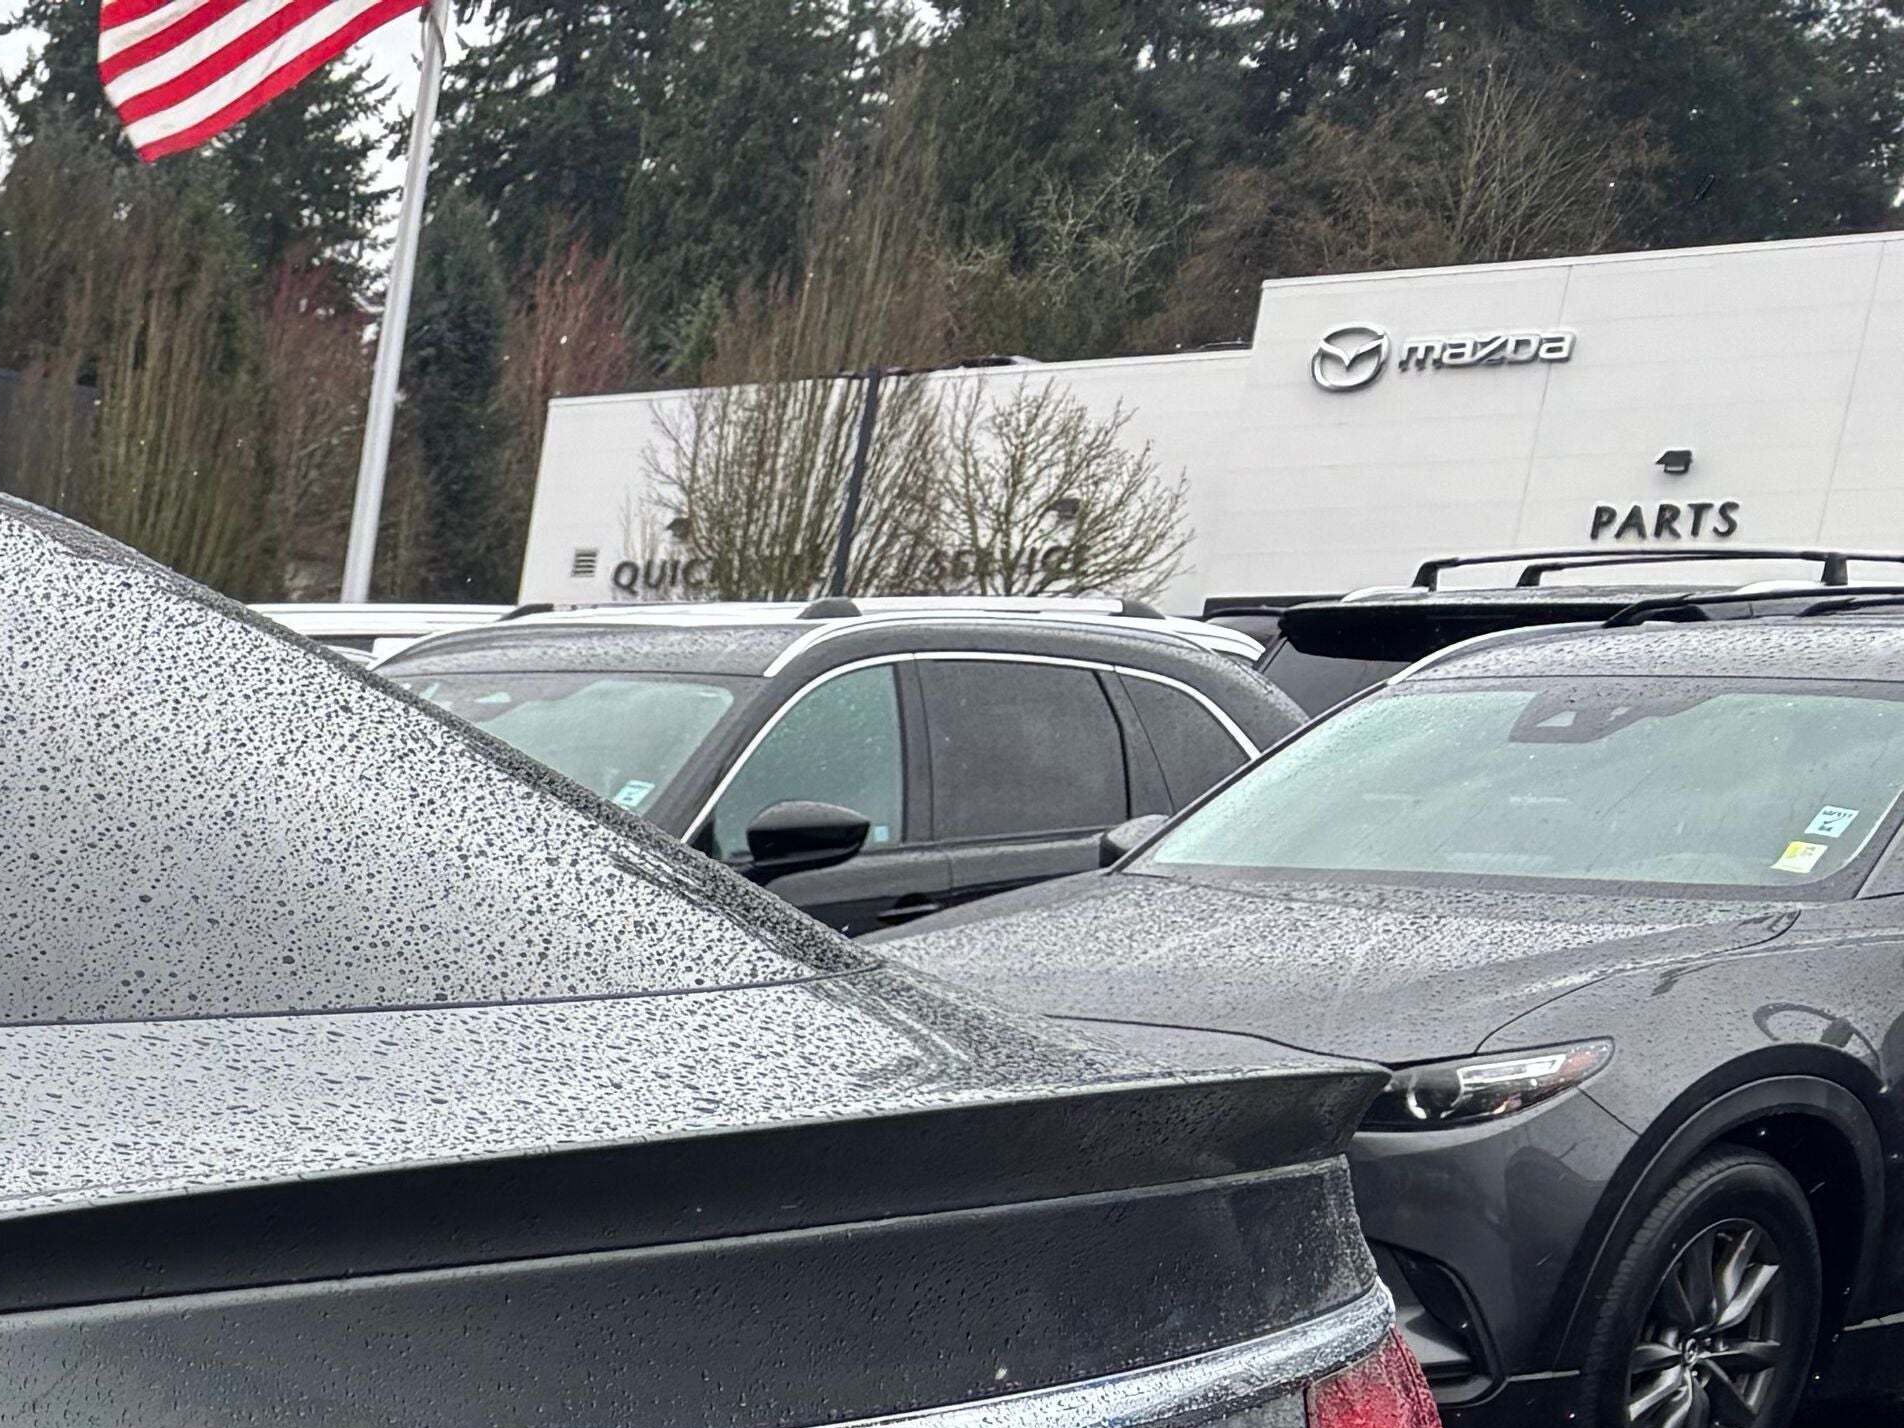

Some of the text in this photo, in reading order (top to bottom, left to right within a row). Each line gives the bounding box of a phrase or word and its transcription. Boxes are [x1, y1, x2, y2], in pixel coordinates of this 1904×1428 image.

[1398, 329, 1578, 371] mazda
[1589, 500, 1741, 541] PARTS
[613, 557, 722, 596] QUIC
